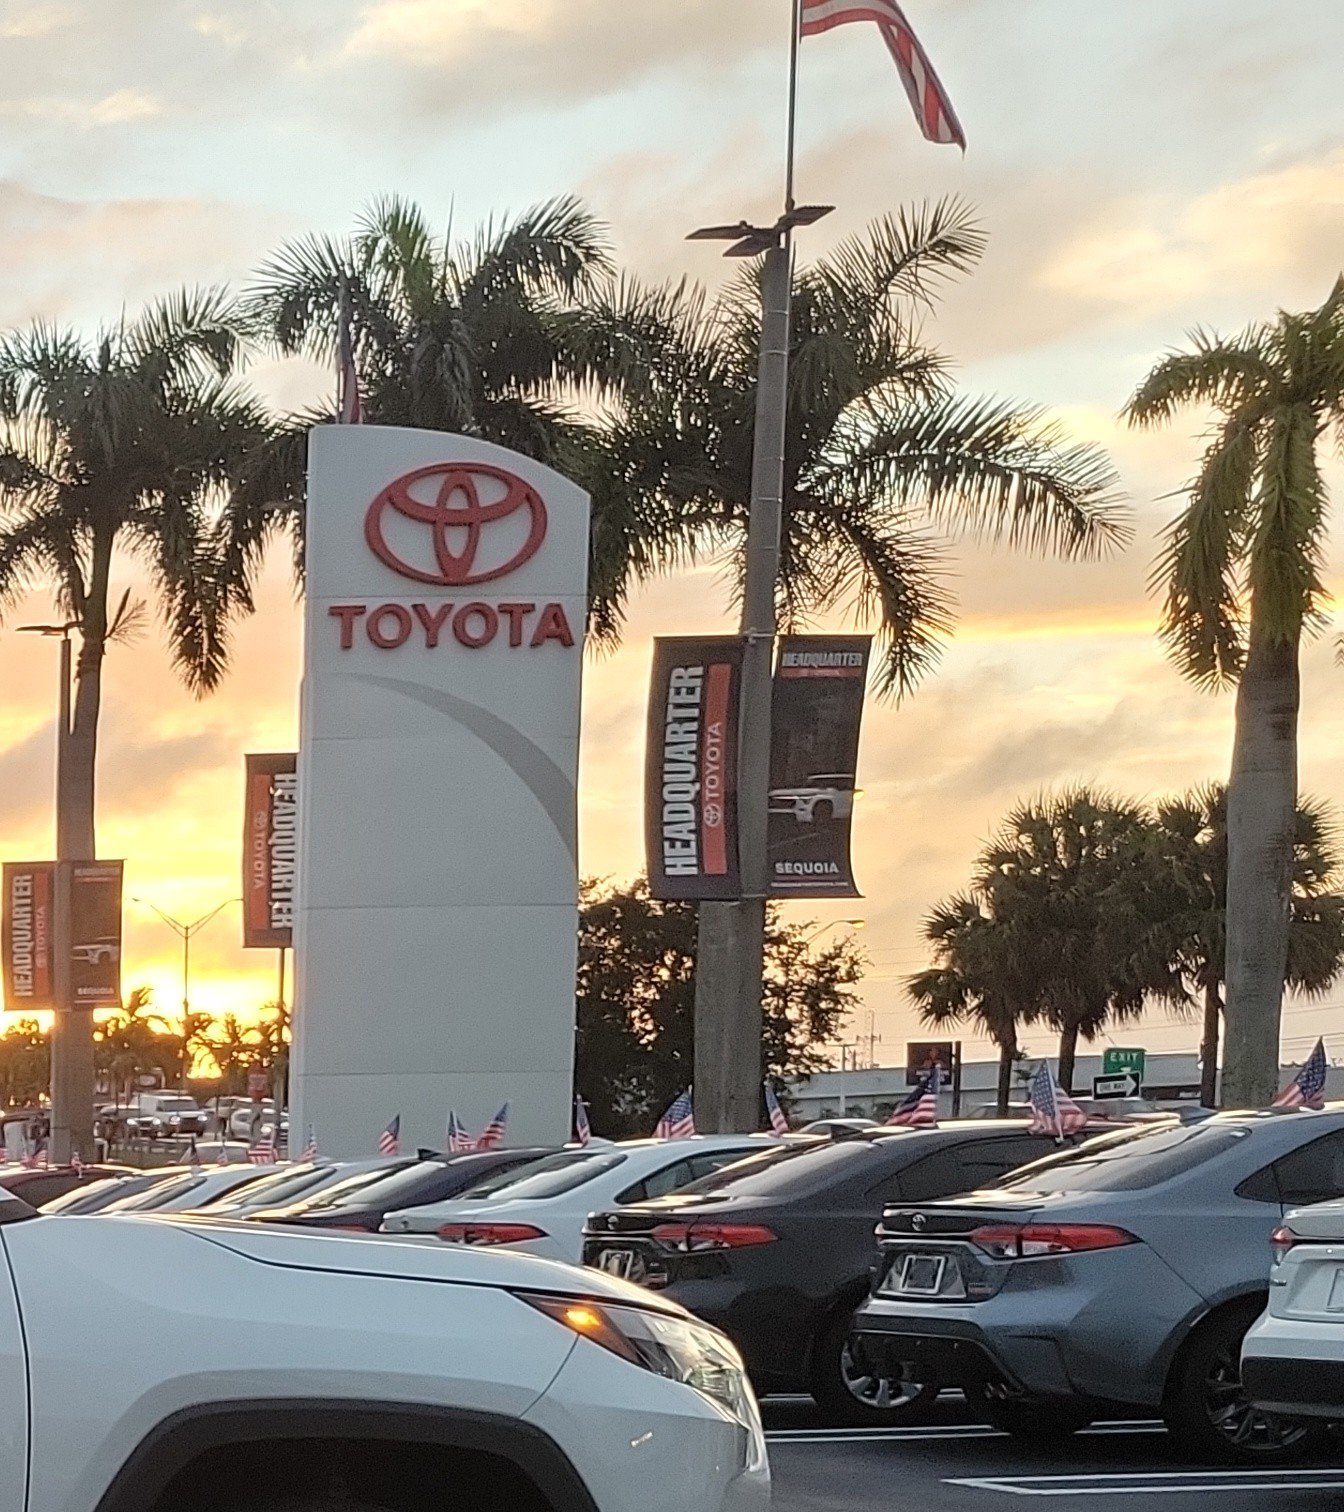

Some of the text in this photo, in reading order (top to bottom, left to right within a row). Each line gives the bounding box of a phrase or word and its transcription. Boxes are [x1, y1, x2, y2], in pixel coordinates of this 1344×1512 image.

[328, 602, 574, 649] TOYOTA
[782, 652, 862, 667] HEADQUARTER
[662, 666, 704, 876] HEADQUARTER
[705, 722, 722, 800] TOYOTA
[271, 773, 297, 929] HEADQUARTER
[774, 862, 839, 875] SEQUOIA
[13, 874, 33, 997] HEADQUARTER
[1110, 1052, 1138, 1062] EXIT
